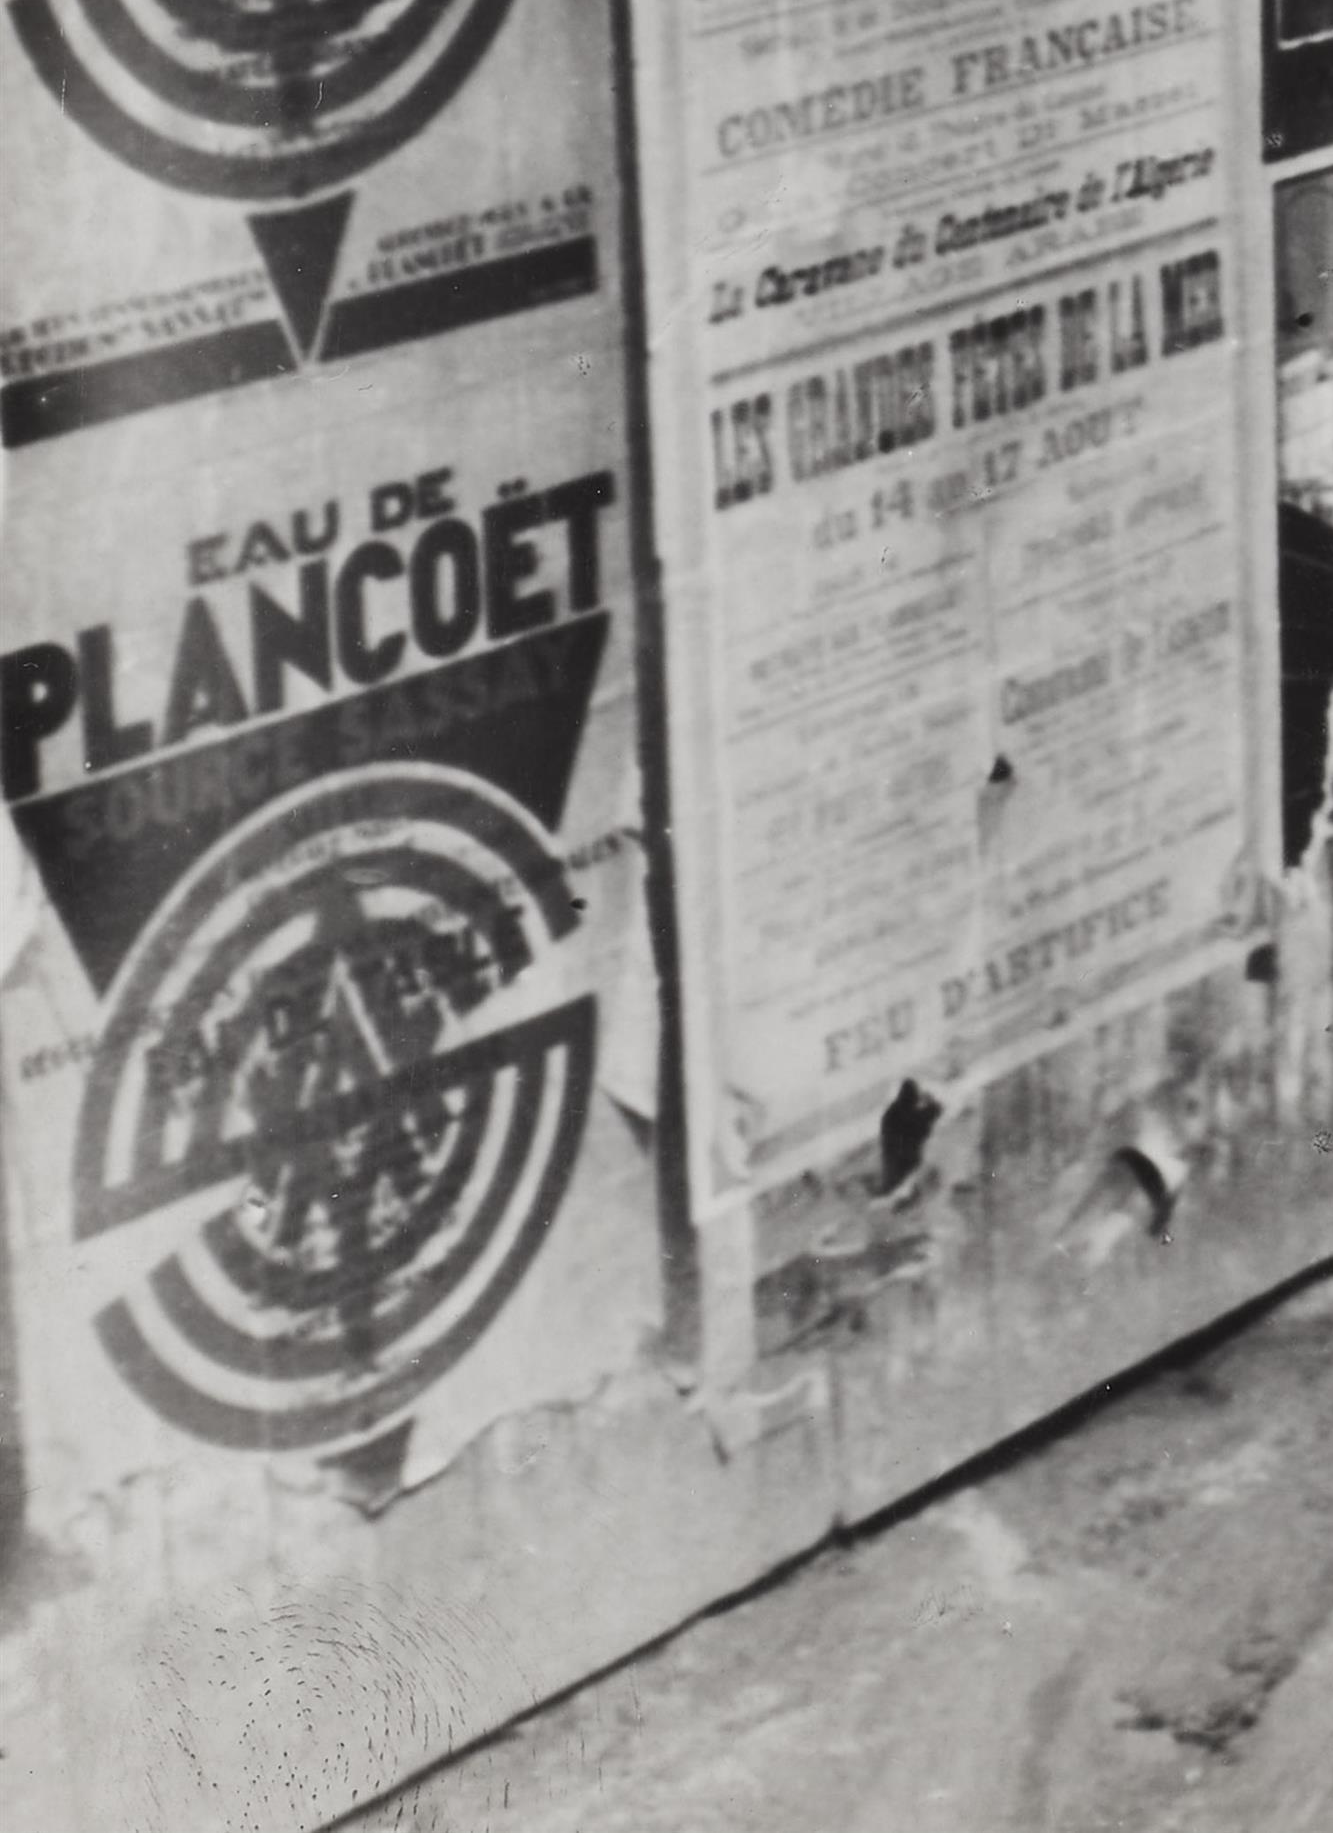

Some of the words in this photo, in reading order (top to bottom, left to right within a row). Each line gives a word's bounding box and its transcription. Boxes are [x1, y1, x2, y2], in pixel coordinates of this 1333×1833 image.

[1108, 271, 1150, 377] LA
[981, 437, 1024, 489] 17
[184, 497, 341, 589] EAU
[367, 466, 458, 531] DE
[0, 472, 614, 801] PLANCOËT
[823, 995, 916, 1076] FEU
[940, 875, 1171, 1020] D'ARTIFICE
